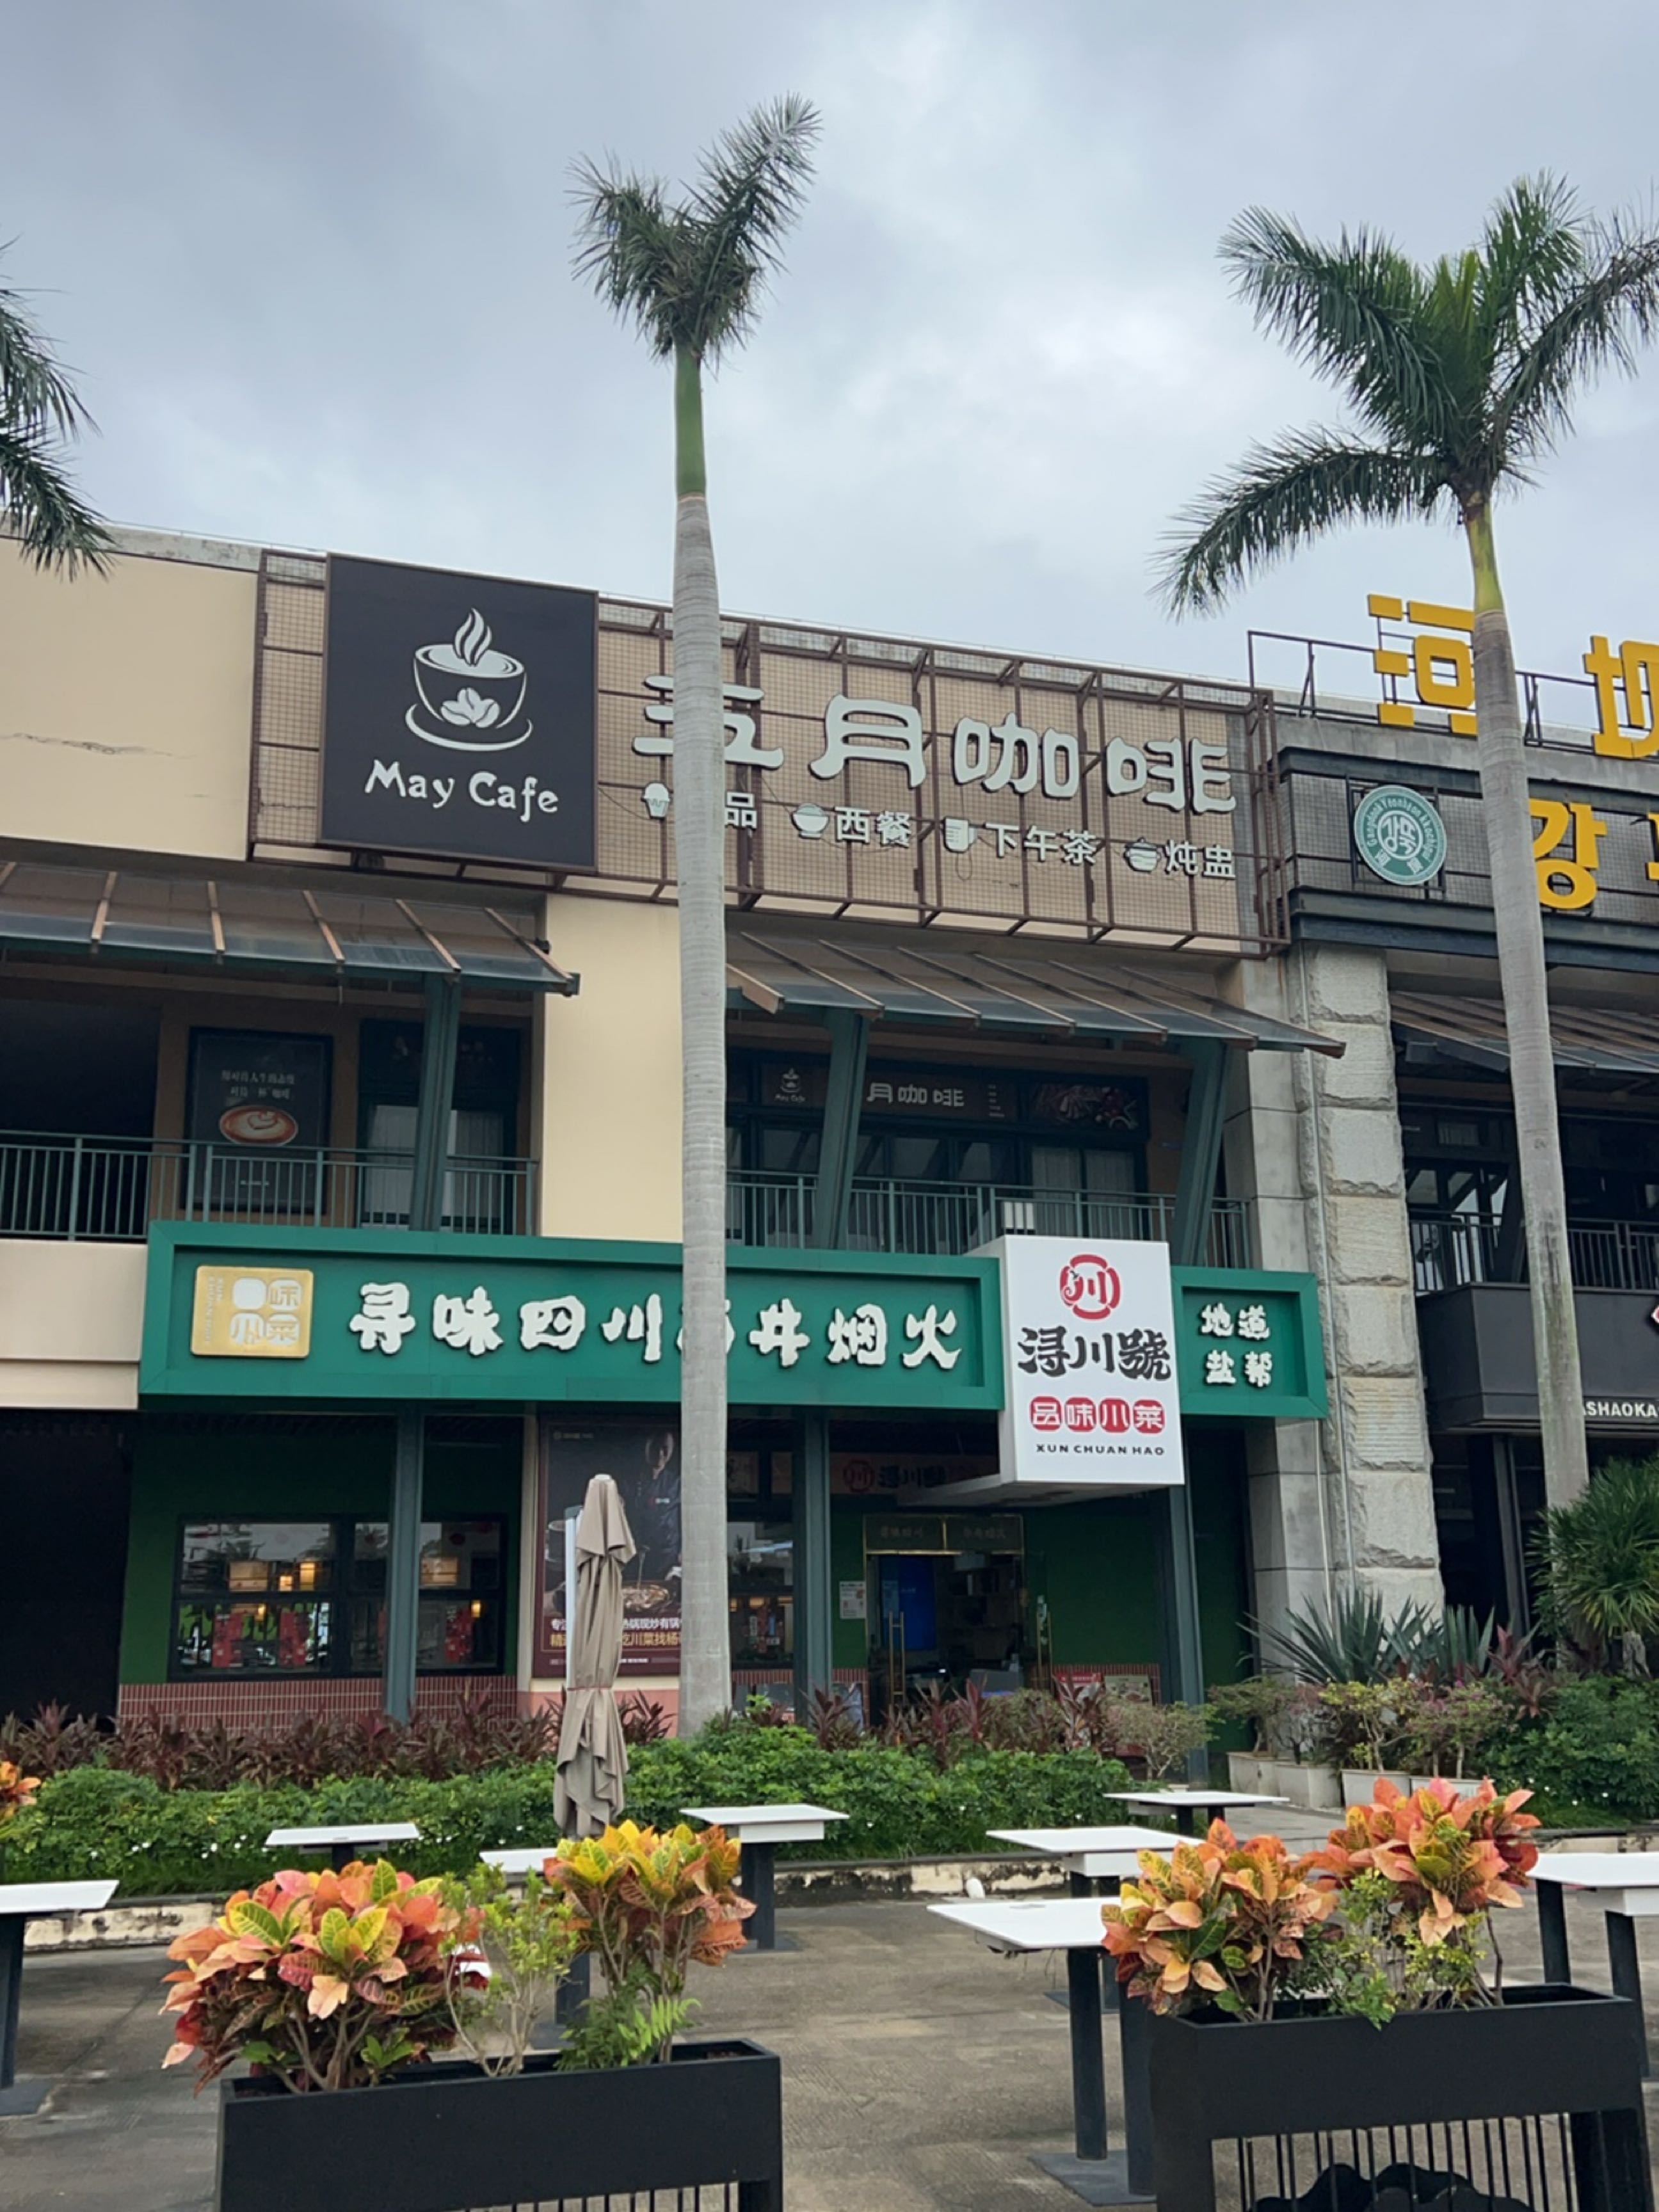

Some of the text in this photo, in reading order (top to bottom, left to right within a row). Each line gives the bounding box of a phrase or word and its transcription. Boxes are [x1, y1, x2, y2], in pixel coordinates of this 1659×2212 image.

[632, 675, 1236, 815] 五月咖啡
[365, 760, 559, 822] May Cafe
[725, 792, 757, 830] 品
[835, 806, 911, 847] 西餐
[985, 822, 1096, 864] 下午茶
[1165, 839, 1236, 879] 炖盅
[866, 1082, 965, 1107] 月咖啡
[349, 1283, 962, 1369] 寻味四川井烟火
[1199, 1302, 1270, 1340] 地道
[1583, 1400, 1659, 1418] SHAOKA
[1036, 1444, 1165, 1457] XUN CHUAN HAO
